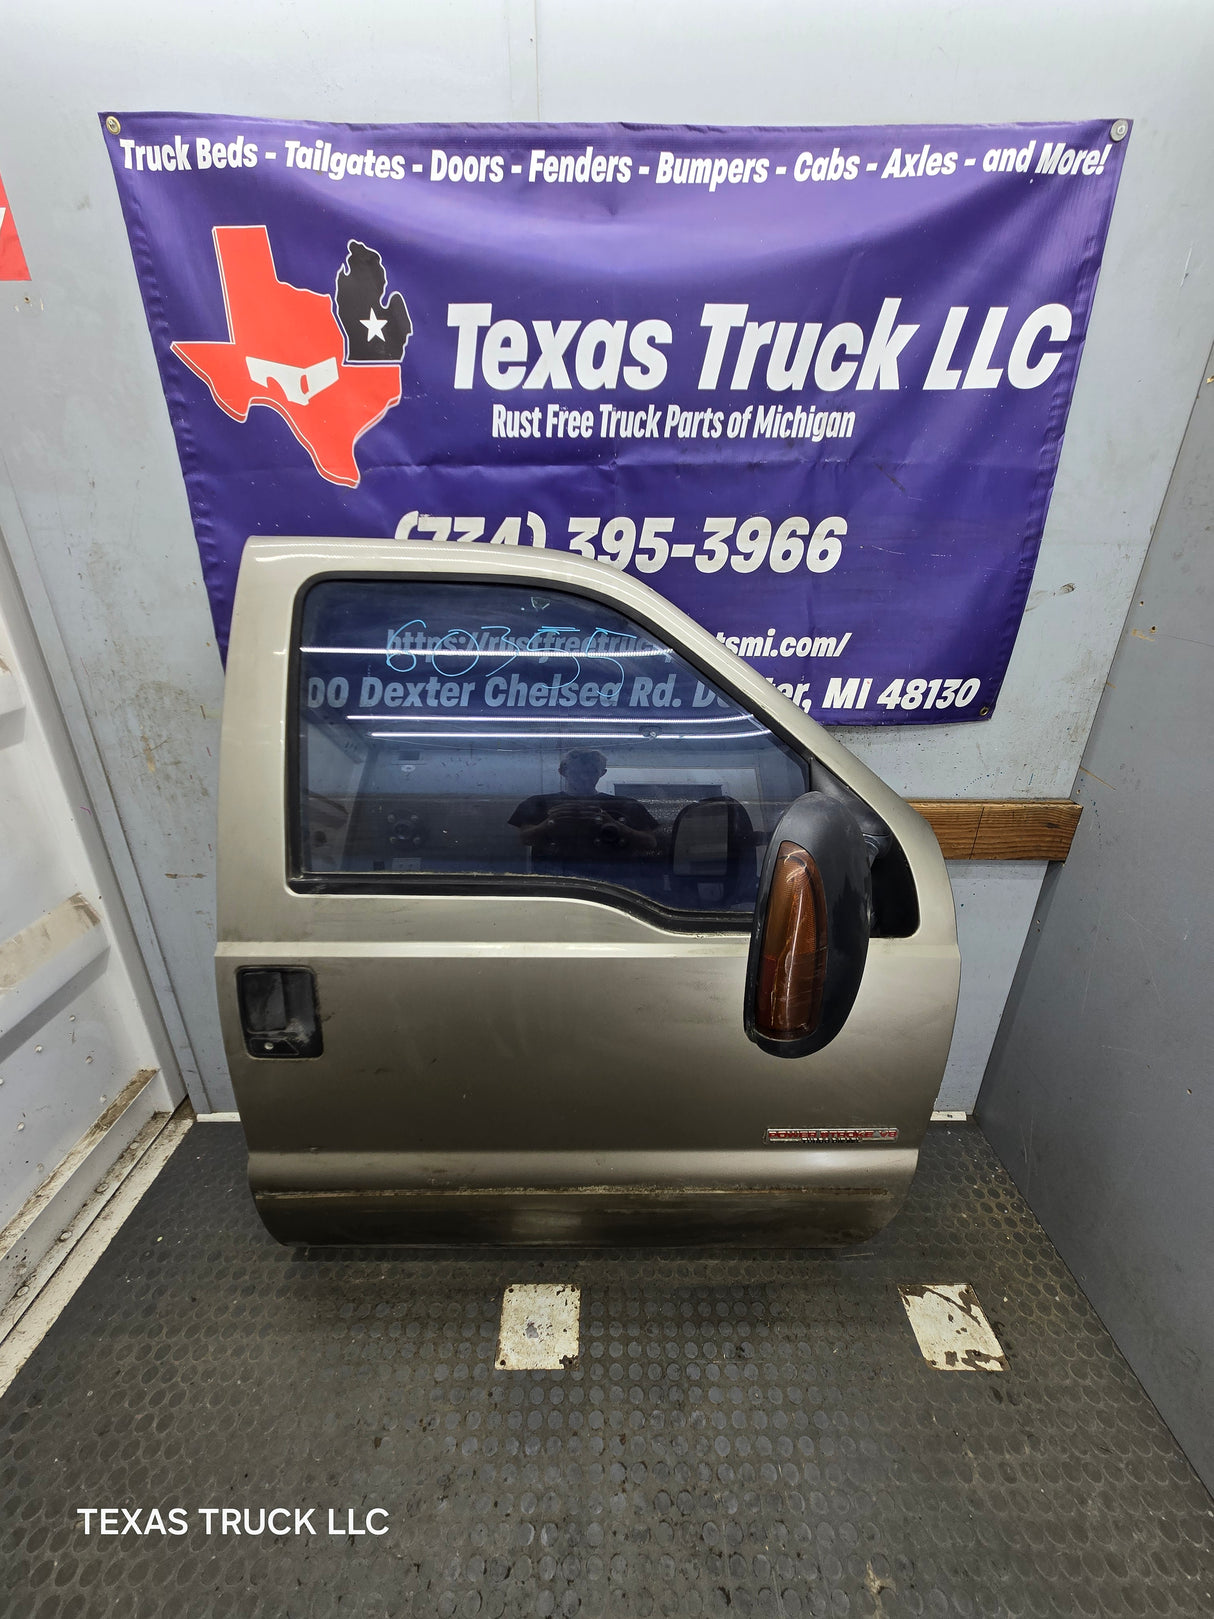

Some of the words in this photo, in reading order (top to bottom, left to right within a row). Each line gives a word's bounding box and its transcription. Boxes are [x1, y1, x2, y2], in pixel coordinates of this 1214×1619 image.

[119, 135, 192, 172] Truck
[195, 135, 259, 170] Beds
[284, 139, 406, 181] Tailgates
[430, 149, 505, 183] Doors
[528, 146, 633, 184] Fenders
[655, 151, 770, 193] Bumpers
[793, 147, 861, 182] Cabs
[880, 144, 959, 179] Axles
[982, 139, 1037, 173] and
[1034, 142, 1113, 176] More!
[447, 303, 673, 391] Texas
[697, 297, 921, 392] Truck
[922, 303, 1072, 390] LLC
[492, 403, 543, 438] Rust
[545, 403, 594, 438] Free
[599, 403, 663, 438] Truck
[663, 404, 725, 439] Parts
[726, 404, 754, 439] of
[752, 404, 856, 443] Michigan
[567, 516, 848, 574] 395-3966
[359, 676, 475, 708] Dexter
[484, 674, 622, 708] Chelsea
[629, 673, 682, 708] Rd.
[821, 677, 874, 709] MI
[876, 677, 981, 710] 48130
[768, 1130, 817, 1139] POWER
[820, 1130, 874, 1139] STROKE
